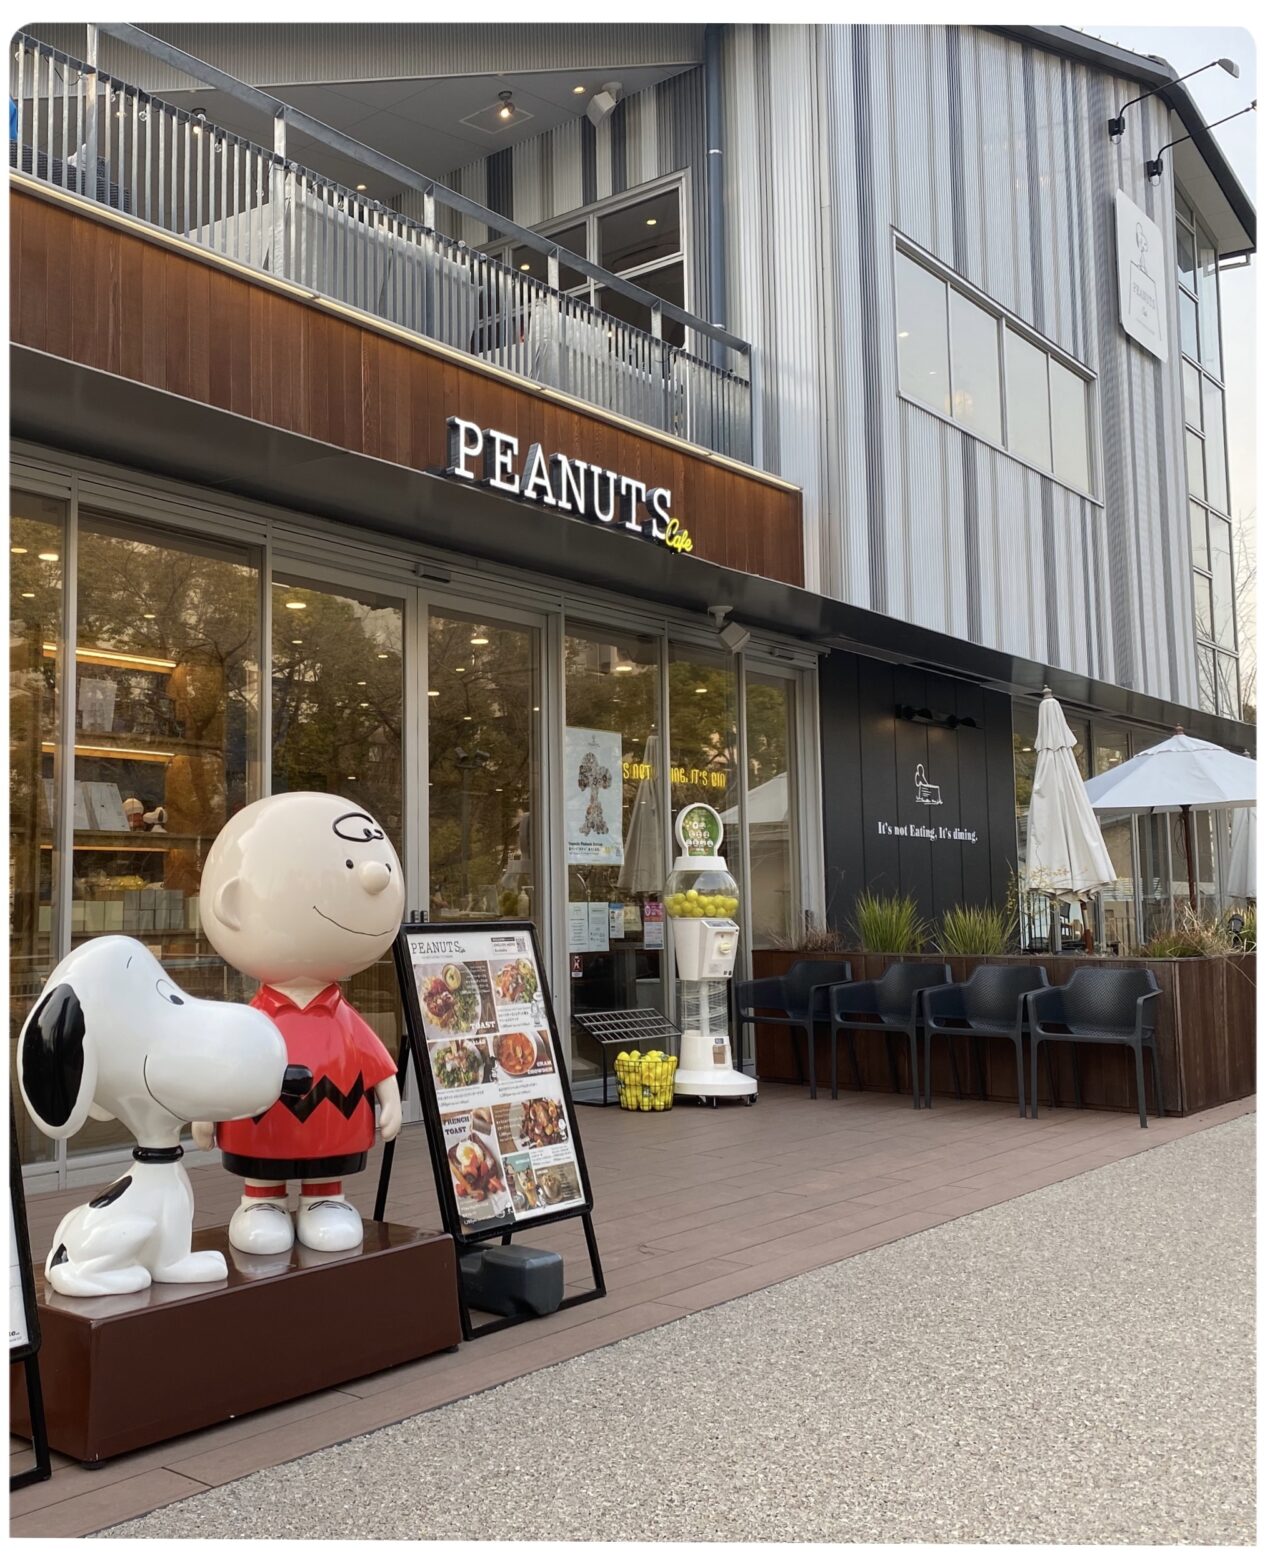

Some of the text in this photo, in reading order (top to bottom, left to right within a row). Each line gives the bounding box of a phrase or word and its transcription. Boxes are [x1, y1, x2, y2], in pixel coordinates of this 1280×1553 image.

[447, 416, 694, 554] PEANUTS Cafe
[877, 821, 978, 844] It's not Eating, It's dining.
[411, 940, 460, 954] PEANUTS
[445, 1126, 467, 1136] TOAST
